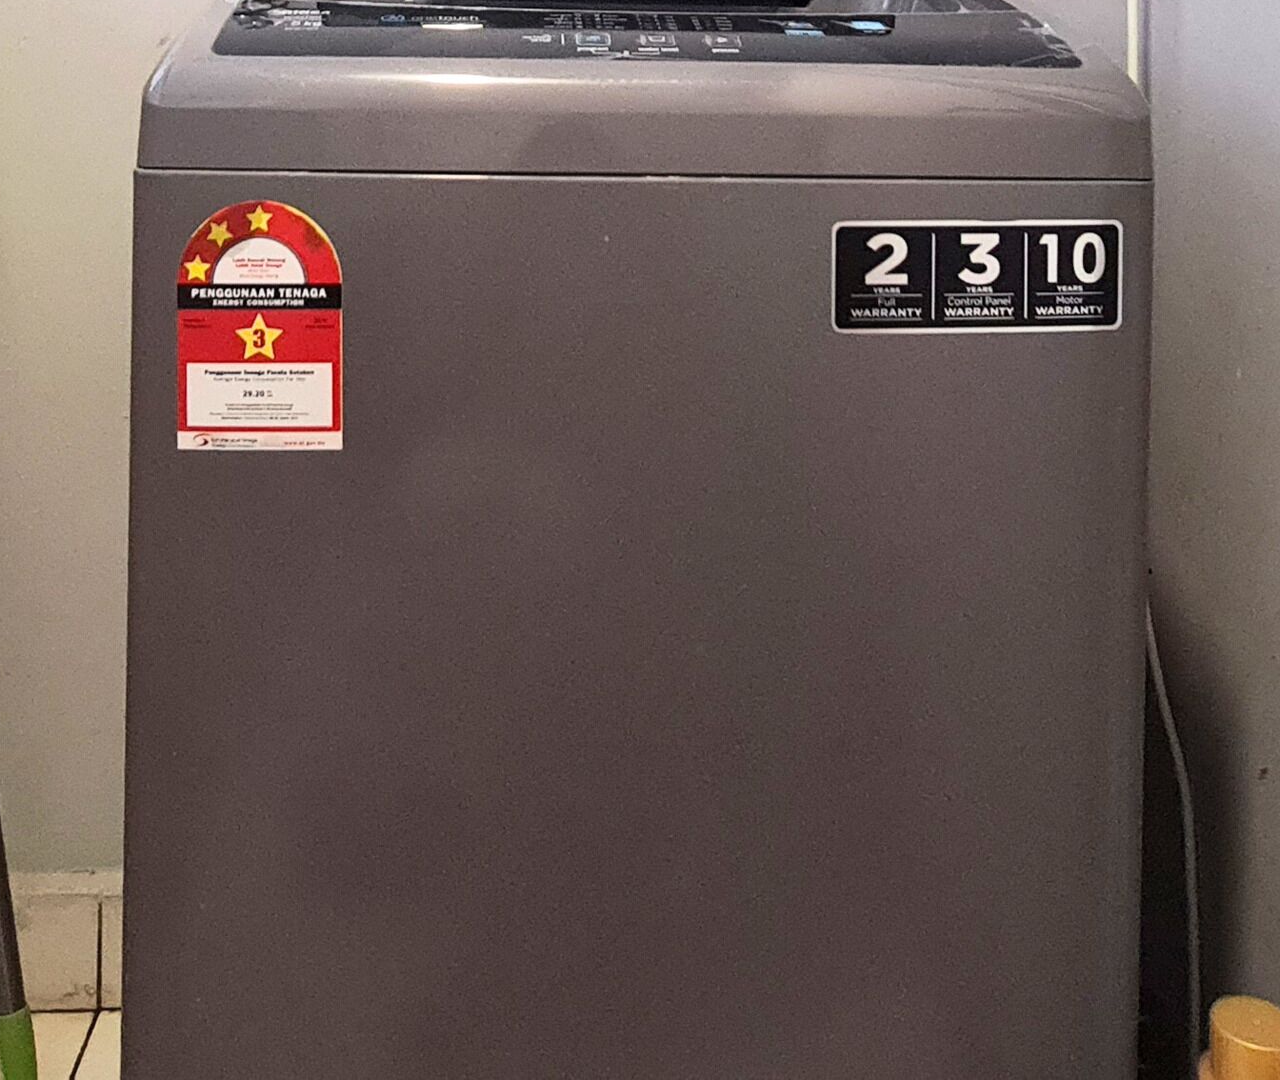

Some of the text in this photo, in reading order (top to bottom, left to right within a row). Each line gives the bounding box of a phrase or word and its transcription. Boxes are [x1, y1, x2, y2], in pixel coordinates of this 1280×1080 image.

[864, 232, 909, 286] 2
[957, 232, 1001, 286] 3
[1039, 232, 1106, 284] 10
[191, 288, 327, 298] PENGGUNAAN TENAGA
[873, 286, 901, 294] YEARS
[966, 286, 993, 294] YEARS
[1057, 285, 1083, 293] YEARS
[877, 297, 896, 307] Full
[947, 296, 1012, 307] Control Panel
[1056, 295, 1083, 305] Motor
[851, 307, 922, 318] WARRANTY
[944, 307, 1014, 318] WARRANTY
[1035, 305, 1104, 316] WARRANTY
[252, 329, 266, 348] 3
